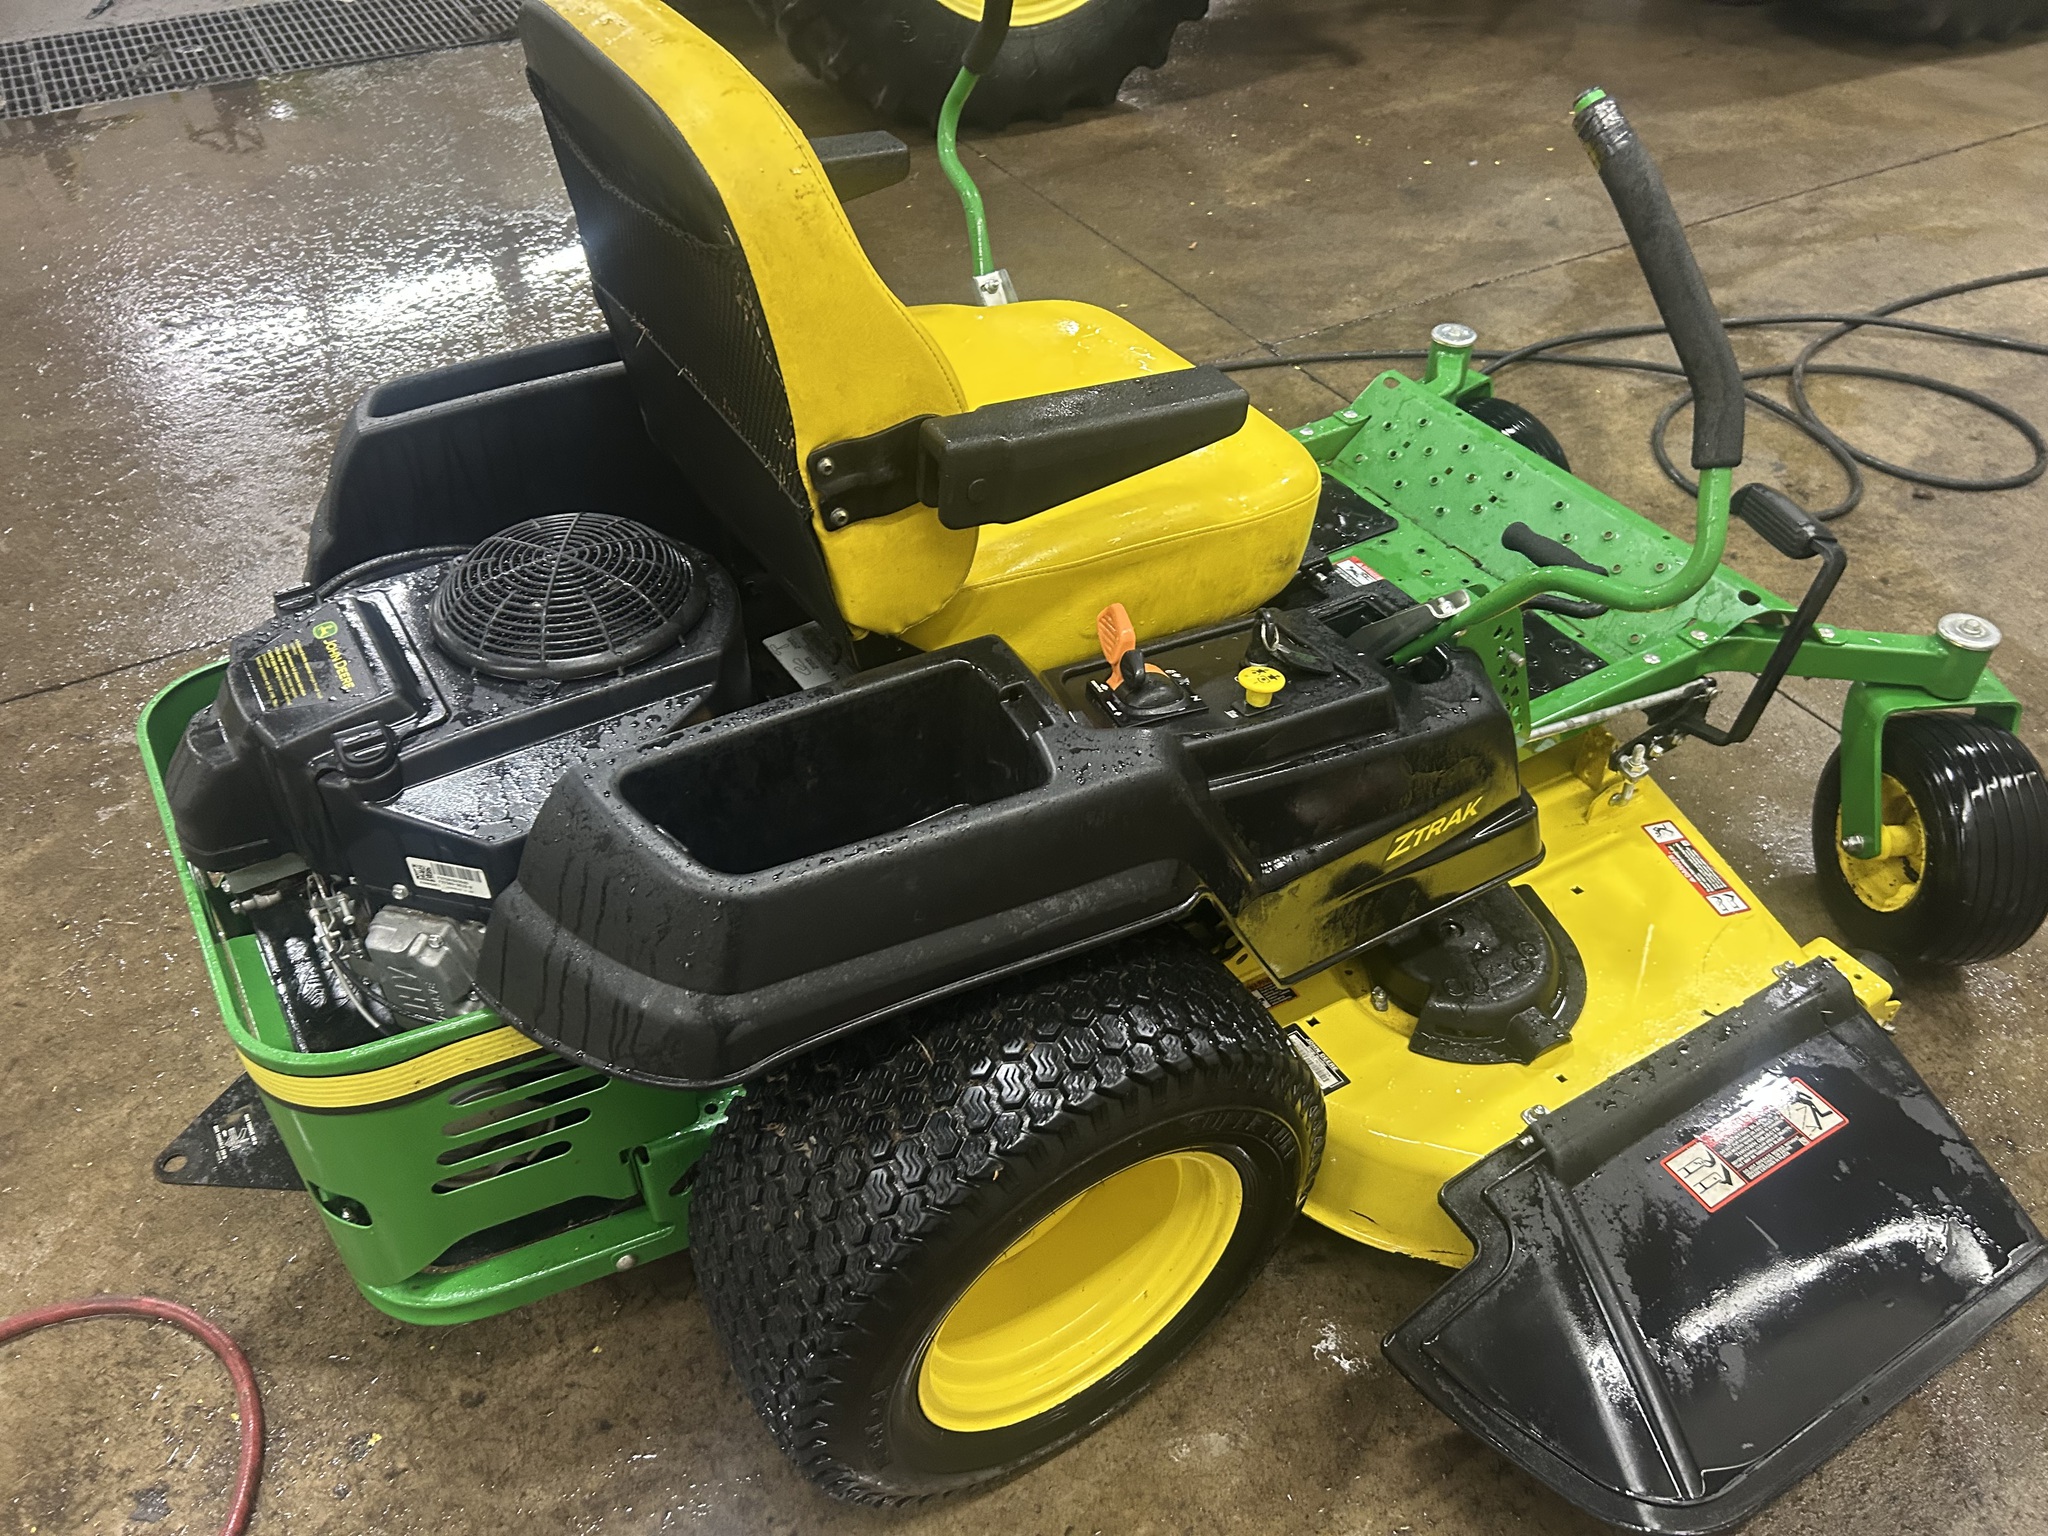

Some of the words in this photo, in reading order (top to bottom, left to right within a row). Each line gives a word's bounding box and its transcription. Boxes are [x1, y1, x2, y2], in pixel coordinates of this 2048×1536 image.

[323, 639, 340, 664] JOHN
[334, 660, 356, 689] DEERE
[1386, 796, 1484, 862] ZTRAK
[1668, 855, 1693, 879] DANGER
[1304, 1037, 1322, 1053] JOHN
[1319, 1053, 1339, 1071] DEERE
